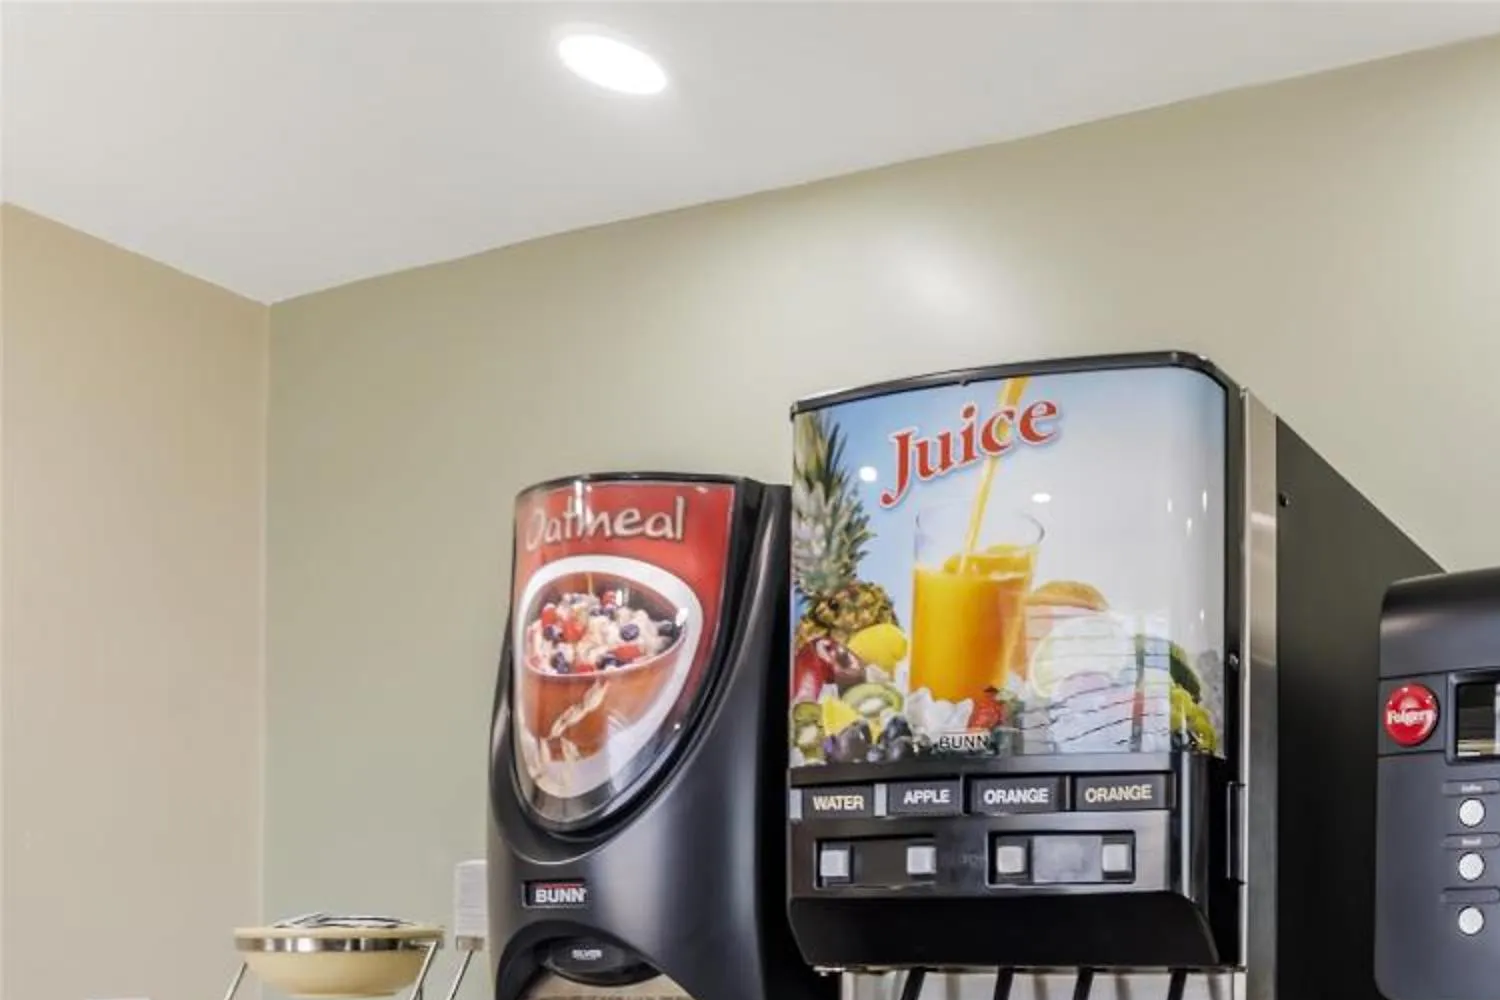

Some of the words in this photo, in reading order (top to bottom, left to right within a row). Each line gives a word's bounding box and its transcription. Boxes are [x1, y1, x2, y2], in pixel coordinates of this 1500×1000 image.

[880, 399, 1060, 508] Juice
[525, 496, 685, 551] Oatmeal
[939, 735, 990, 750] BUNN
[903, 789, 950, 804] APPLE
[984, 788, 1049, 805] ORANGE
[1084, 784, 1153, 803] ORANGE
[813, 795, 865, 811] WATER
[535, 887, 586, 903] BUNN
